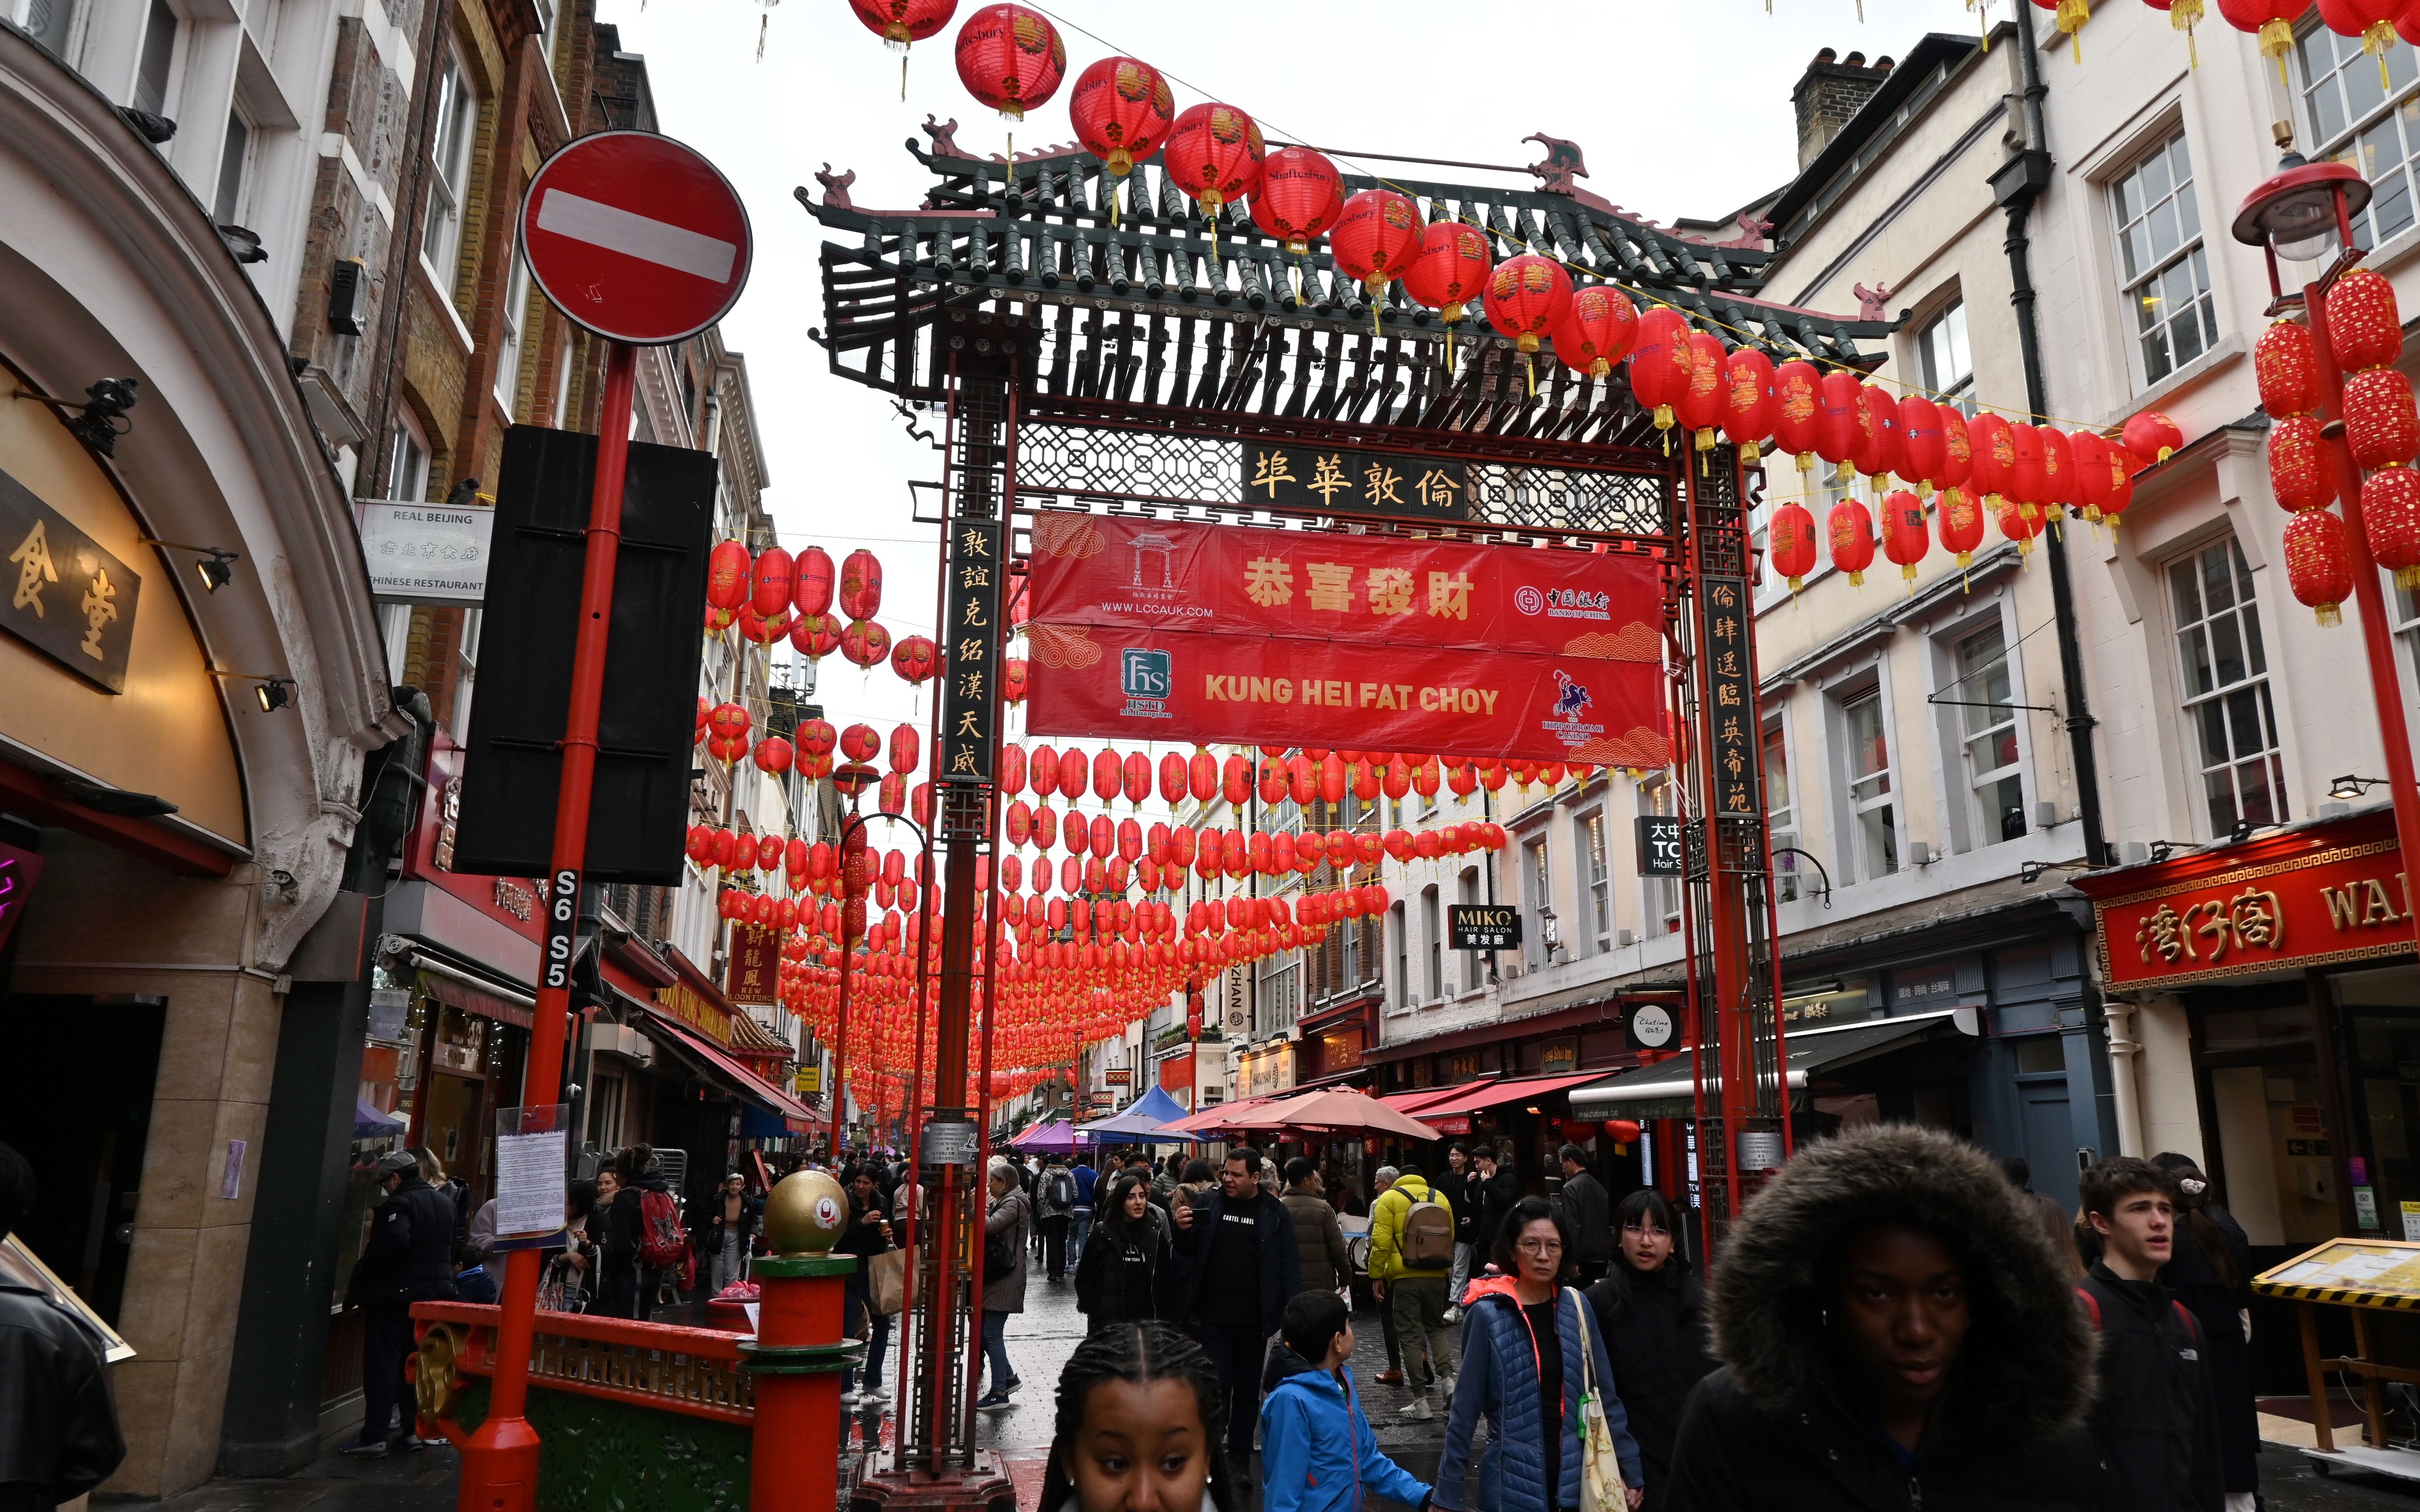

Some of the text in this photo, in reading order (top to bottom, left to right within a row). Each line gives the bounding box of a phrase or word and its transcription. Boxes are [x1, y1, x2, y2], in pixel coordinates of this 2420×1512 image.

[1269, 169, 1331, 184] Shaftesbury
[394, 511, 472, 524] REAL BEIJING
[381, 541, 478, 560] 老北京食府
[414, 579, 483, 590] RESTAURANT
[1244, 556, 1474, 621] 恭喜發財
[1102, 602, 1213, 617] WWW.LCCAUK.COM
[1206, 674, 1499, 716] KUNG HEI FAT CHOY
[1127, 700, 1165, 710] HSTD
[1543, 722, 1604, 733] HIPPODROME
[1556, 731, 1591, 740] CASINO
[1653, 859, 1673, 868] Hair
[1458, 910, 1512, 926] MIKO
[1466, 934, 1504, 945] 美发廊
[1543, 1049, 1554, 1064] Feng
[1554, 1045, 1564, 1061] Shui
[1579, 1108, 1619, 1118] www.chatimeuk.com
[1688, 1184, 1699, 1192] TCW
[1223, 1214, 1254, 1225] CARTEL LABEL
